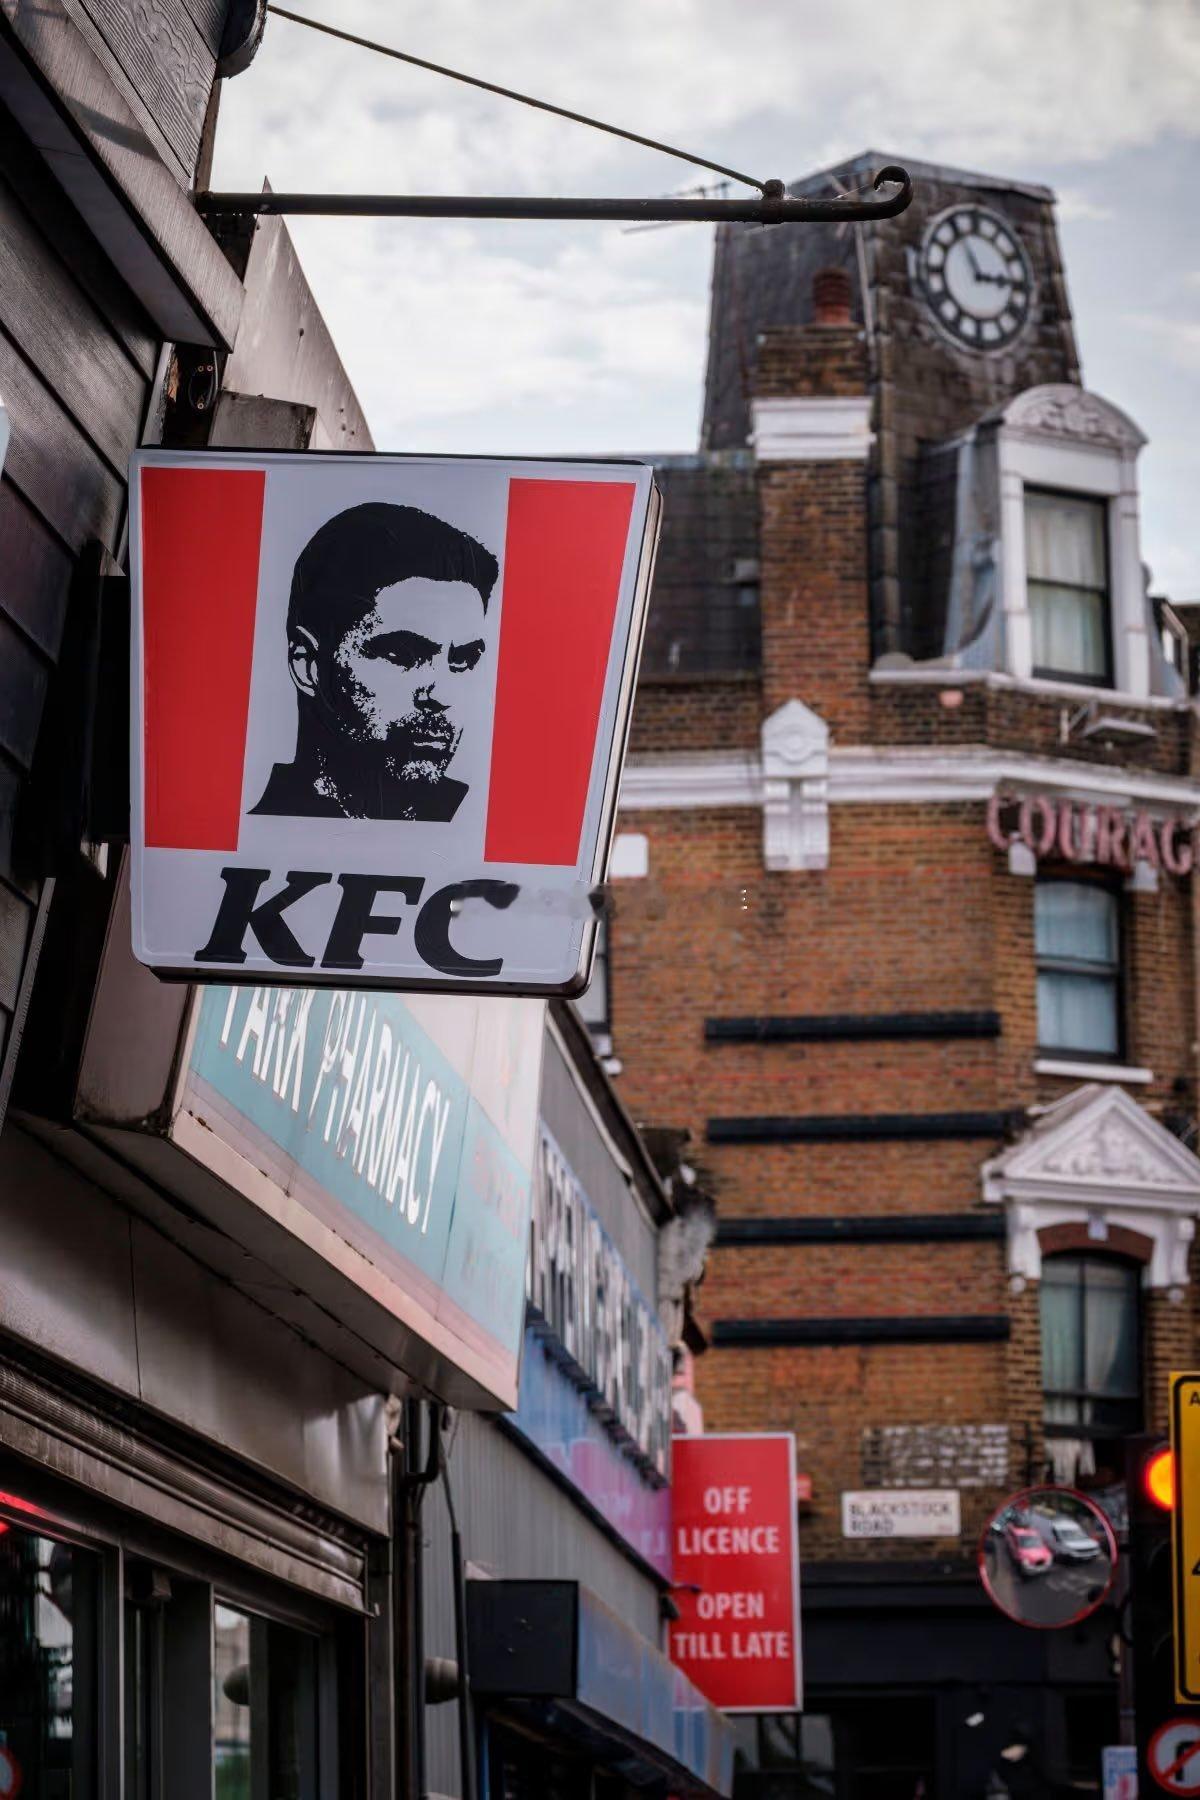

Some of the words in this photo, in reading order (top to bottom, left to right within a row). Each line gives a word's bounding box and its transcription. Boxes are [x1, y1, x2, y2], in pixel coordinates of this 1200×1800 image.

[194, 867, 520, 977] KFC
[308, 989, 450, 1234] PHARMACY
[703, 1486, 751, 1514] OFF
[677, 1526, 780, 1555] LICENCE
[696, 1591, 765, 1619] OPEN
[672, 1632, 726, 1659] TILL
[732, 1631, 790, 1659] LATE
